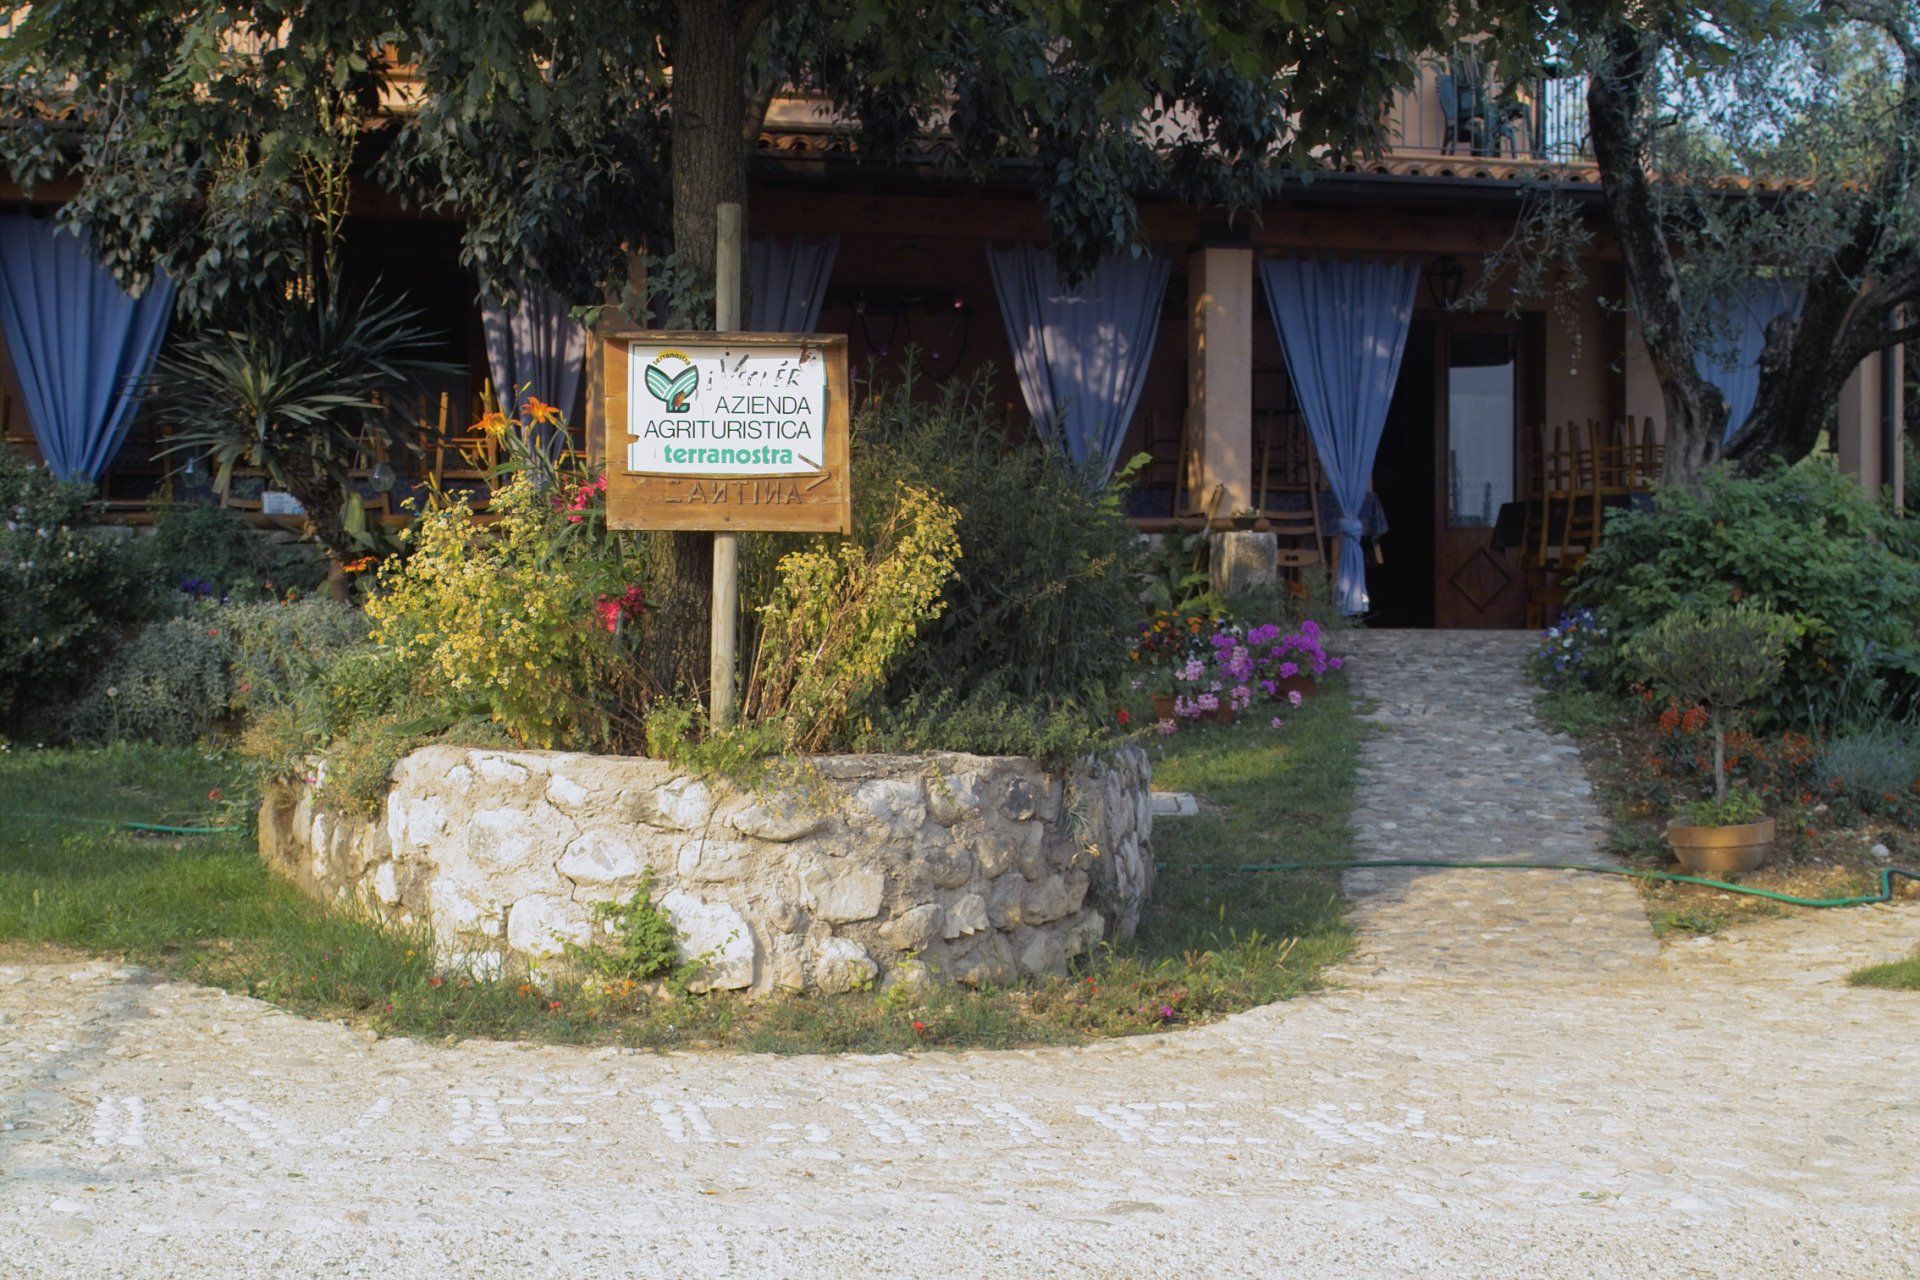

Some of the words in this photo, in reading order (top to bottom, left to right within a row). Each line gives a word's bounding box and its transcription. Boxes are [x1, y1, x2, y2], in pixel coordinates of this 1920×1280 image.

[715, 396, 812, 415] AZIENDA
[644, 419, 812, 439] AGRITURISTICA
[664, 444, 793, 465] terranostra
